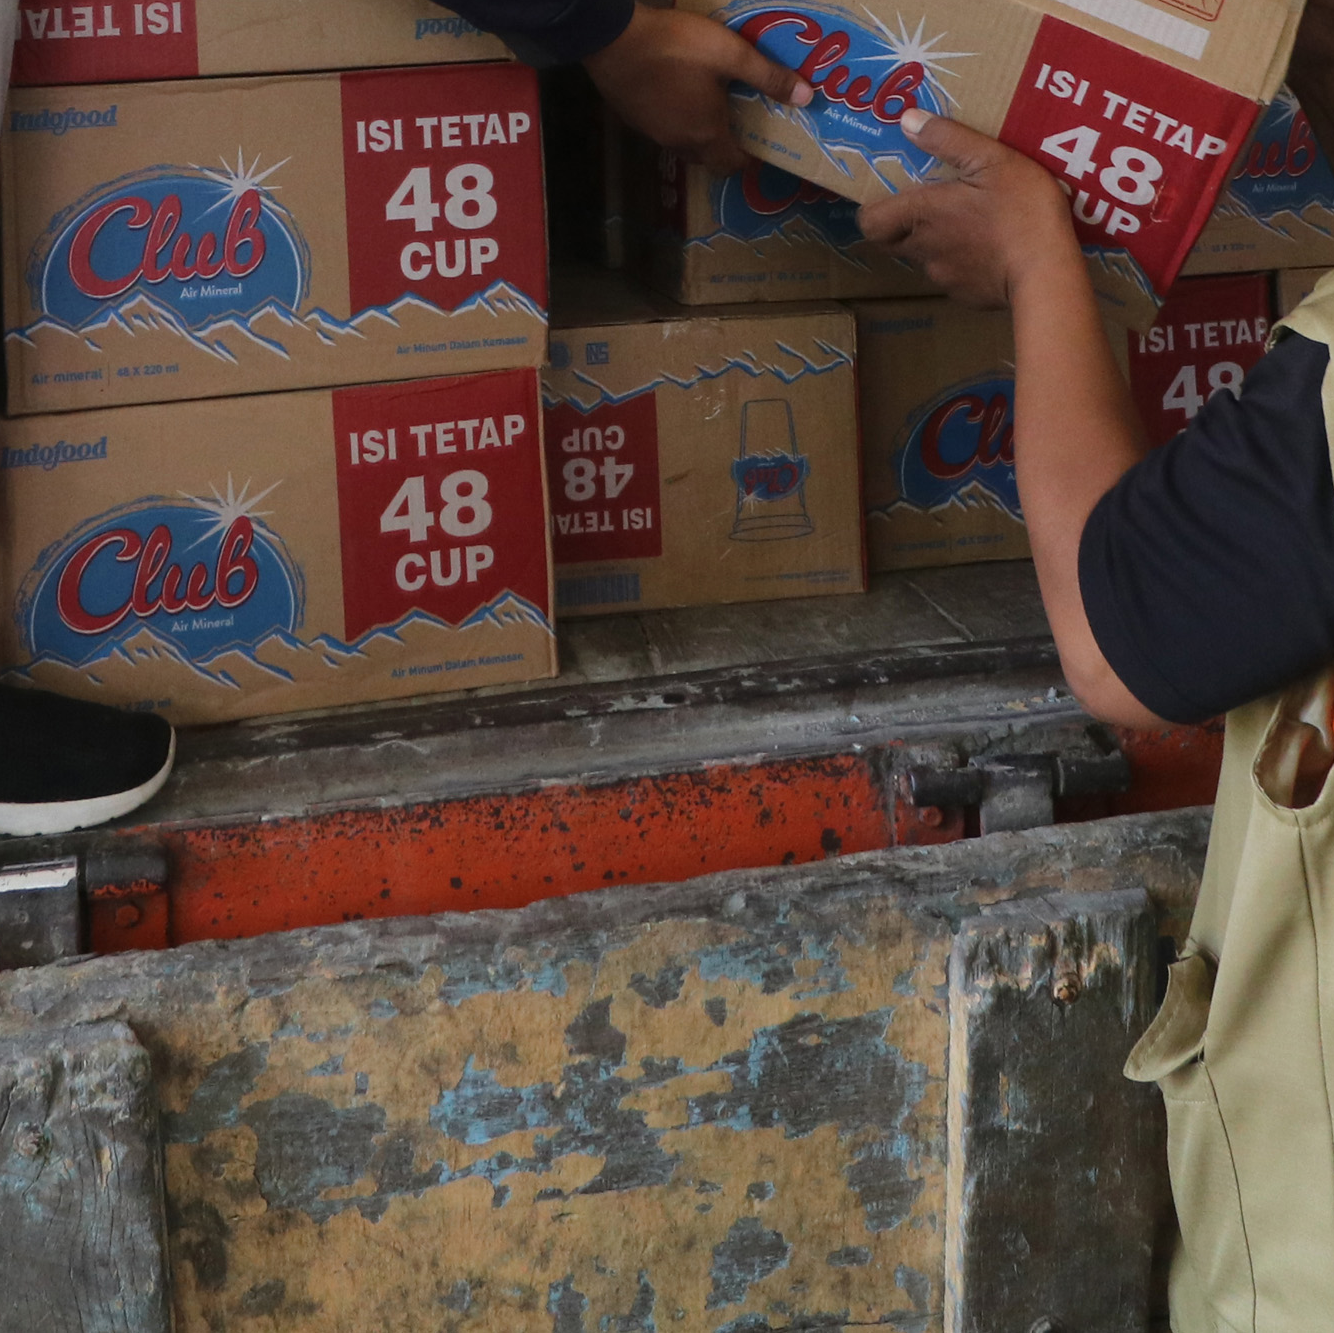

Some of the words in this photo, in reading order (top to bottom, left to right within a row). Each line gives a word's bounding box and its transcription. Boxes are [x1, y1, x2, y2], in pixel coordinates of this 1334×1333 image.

[15, 5, 121, 41] TETA
[134, 1, 183, 36] ISI
[737, 11, 924, 124] Club
[9, 105, 118, 136] Indofood
[823, 106, 839, 121] Air
[841, 115, 883, 137] Mineral
[1034, 63, 1091, 106] ISI
[1102, 89, 1228, 161] TETAP
[357, 118, 404, 154] ISI
[415, 112, 531, 149] TETAP
[770, 140, 787, 155] 220
[1039, 124, 1164, 206] 48
[385, 163, 498, 232] 48
[1252, 183, 1265, 193] Air
[1055, 177, 1141, 237] UP
[69, 188, 266, 300] Club
[399, 237, 500, 281] CUP
[179, 286, 199, 300] Air
[200, 282, 243, 298] Mineral
[396, 344, 411, 355] Air
[413, 342, 447, 354] Minum
[449, 339, 481, 352] Dalam
[482, 335, 528, 349] Kemasan
[1138, 324, 1174, 354] ISI
[1184, 317, 1268, 350] TETAP
[31, 373, 50, 386] Air
[54, 369, 103, 383] mineral
[117, 366, 130, 377] 48
[143, 364, 163, 376] 220
[165, 363, 179, 374] ml
[1, 437, 108, 471] Indofood
[350, 428, 397, 465] ISI
[410, 414, 525, 457] TETAP
[562, 425, 625, 453] CUP
[562, 456, 635, 502] 48
[743, 463, 799, 496] Club
[380, 469, 493, 543] 48
[553, 510, 615, 536] TETA
[622, 507, 652, 531] ISI
[56, 515, 259, 635] Club
[395, 544, 495, 592] CUP
[171, 620, 188, 633] Air
[191, 615, 235, 631] Mineral
[391, 667, 406, 679] Air
[408, 664, 443, 677] Minum
[445, 659, 477, 672] Dalam
[478, 652, 525, 666] Kemasan
